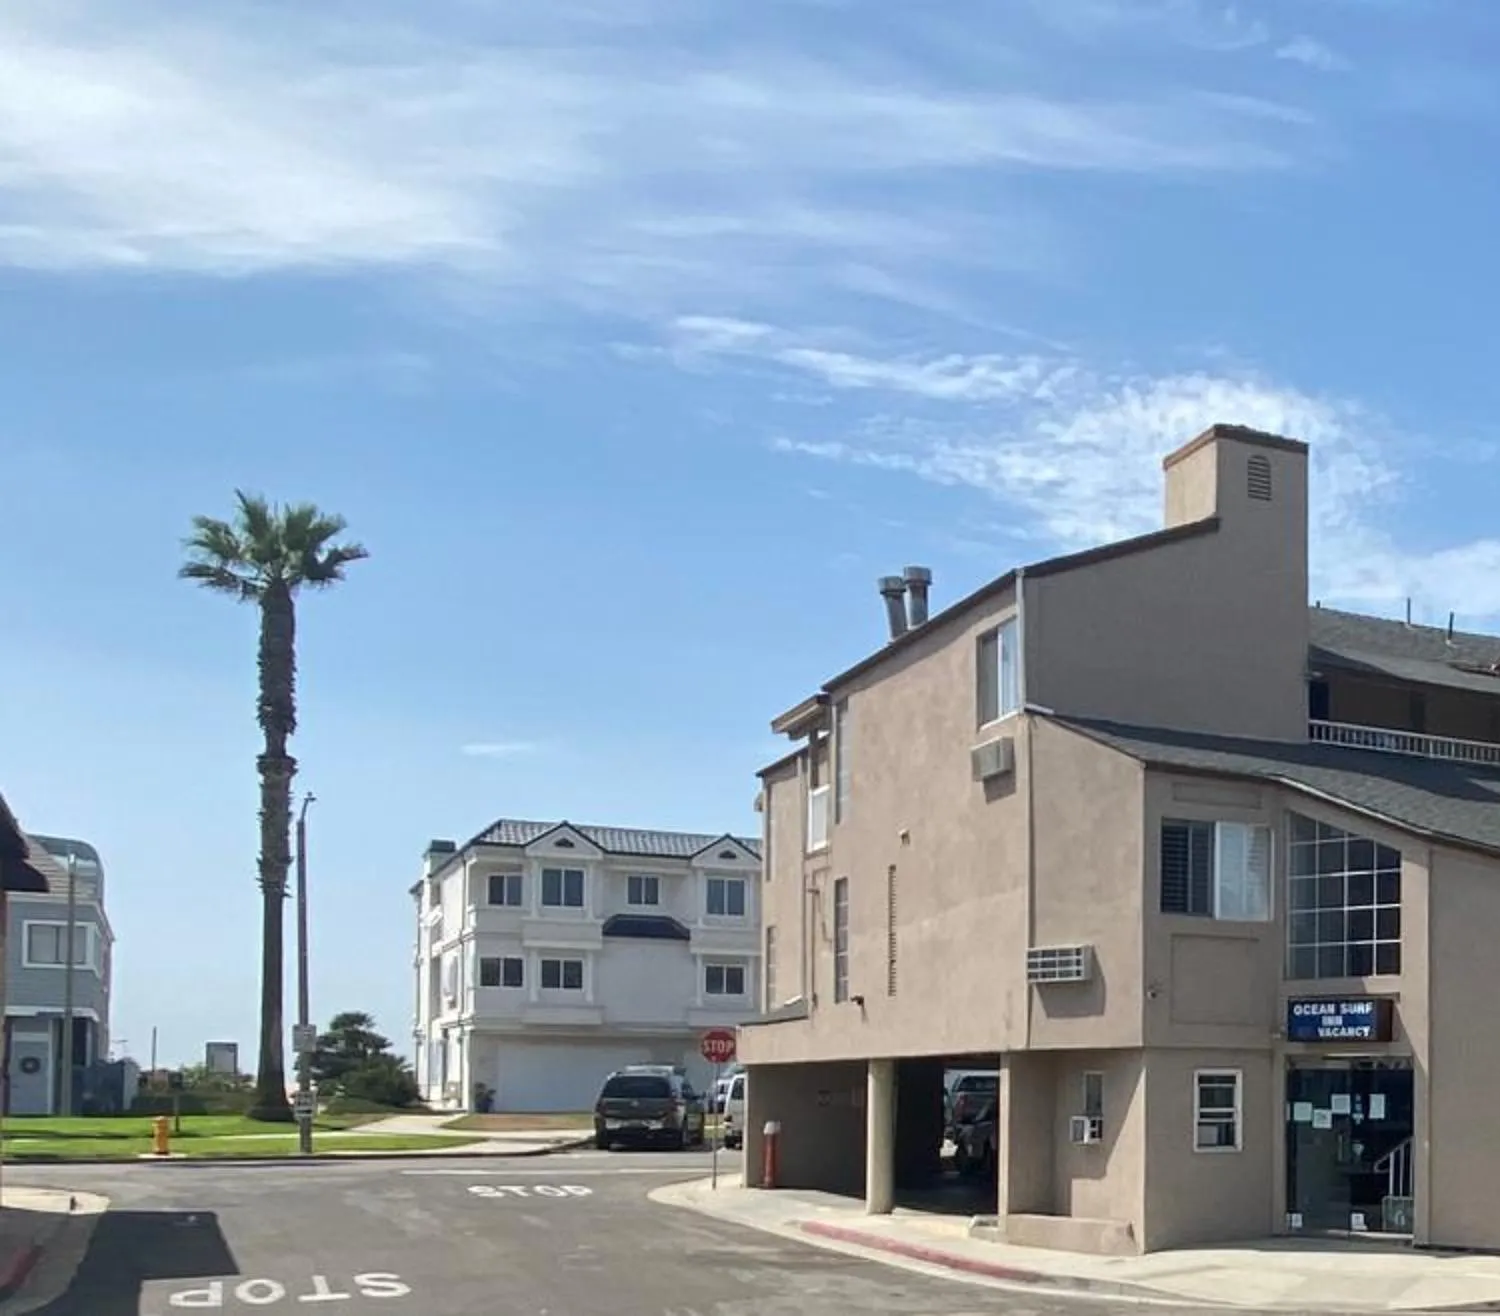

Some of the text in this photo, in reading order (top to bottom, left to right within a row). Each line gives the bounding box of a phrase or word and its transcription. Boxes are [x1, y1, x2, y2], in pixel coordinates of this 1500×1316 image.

[1293, 1002, 1373, 1016] OCEAN SURF
[1321, 1015, 1343, 1026] INN
[1317, 1026, 1371, 1037] VACANCY
[703, 1039, 734, 1053] STOP
[466, 1184, 593, 1198] STOP
[169, 1272, 412, 1307] STOP
